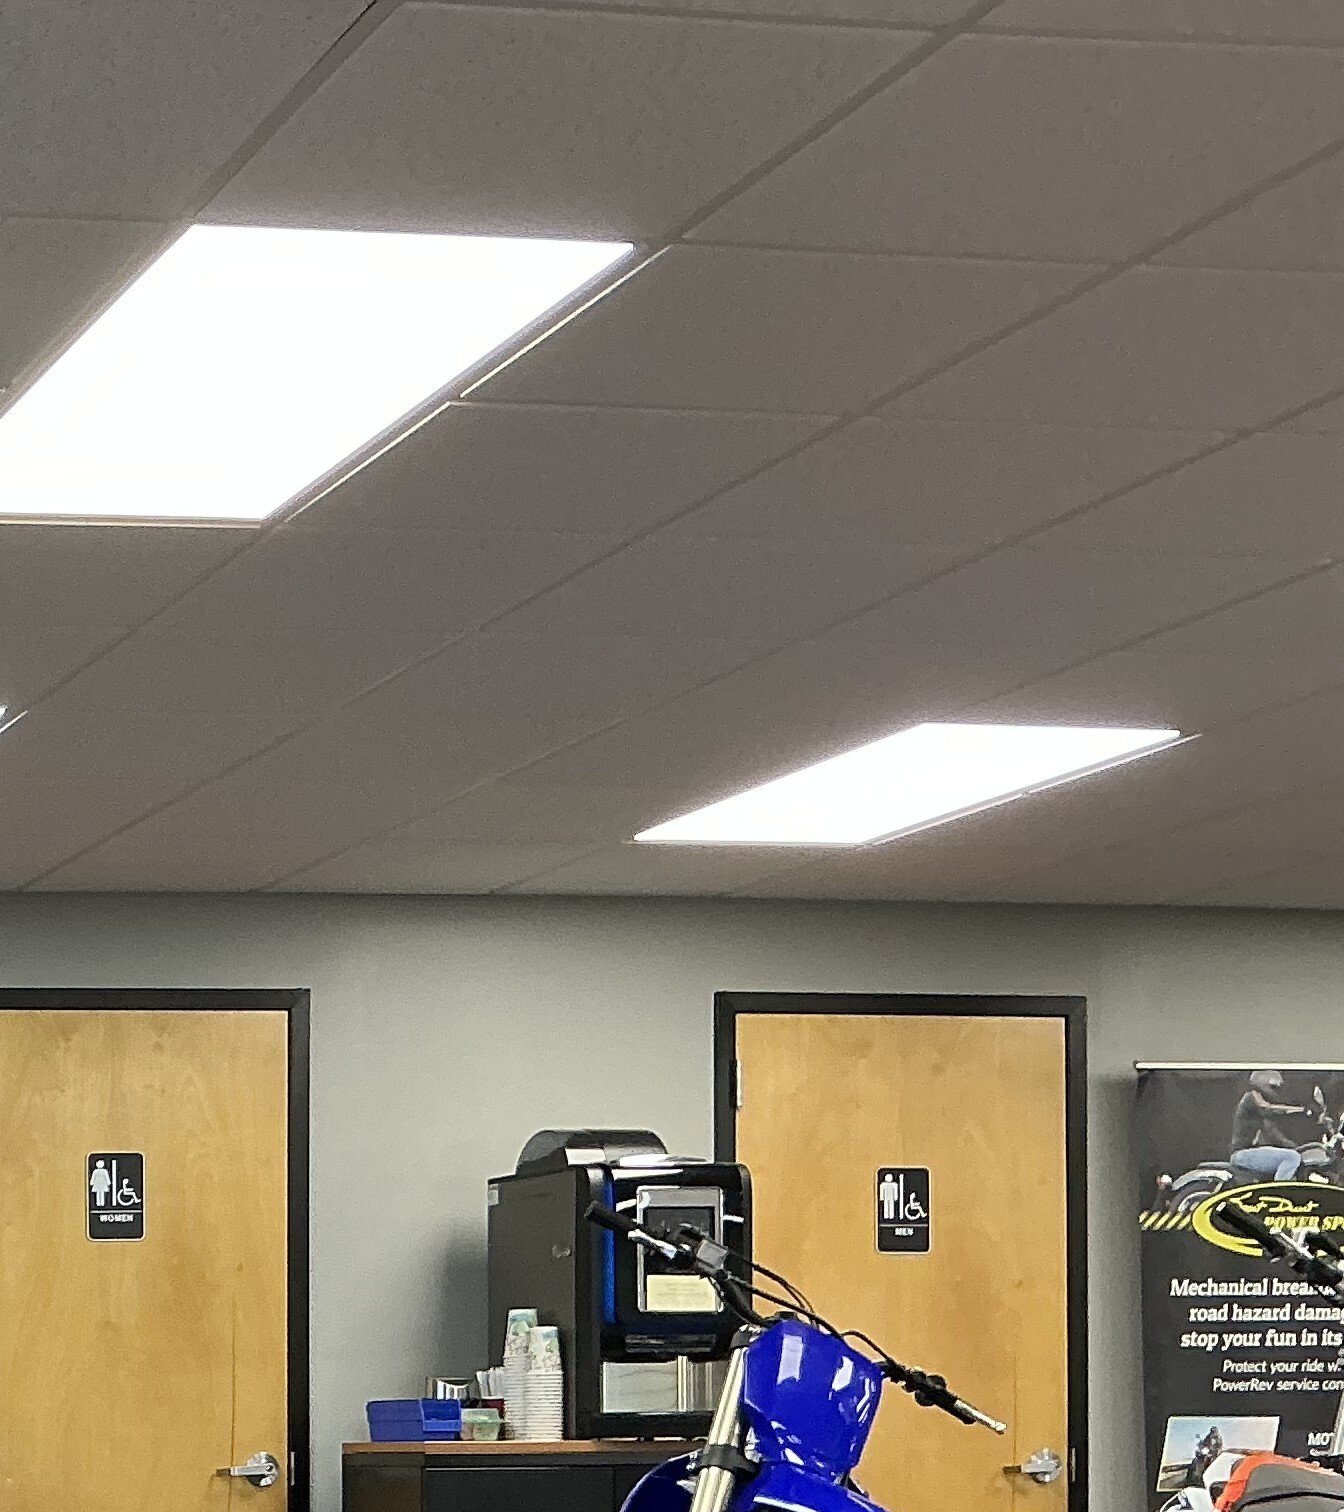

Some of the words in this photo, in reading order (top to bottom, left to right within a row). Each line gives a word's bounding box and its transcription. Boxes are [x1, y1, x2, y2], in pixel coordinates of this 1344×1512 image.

[99, 1214, 133, 1222] WOMEN
[1169, 1277, 1269, 1297] Mechanical
[1189, 1303, 1229, 1322] road
[1231, 1303, 1292, 1322] hazard
[1180, 1331, 1219, 1351] stop
[1221, 1333, 1262, 1351] your
[1264, 1328, 1297, 1347] fun
[1300, 1328, 1318, 1347] in
[1321, 1328, 1343, 1347] its
[1223, 1359, 1267, 1373] Protect
[1270, 1361, 1299, 1375] your
[1301, 1358, 1325, 1373] ride
[1213, 1377, 1274, 1392] PowerRev
[1276, 1377, 1320, 1391] service
